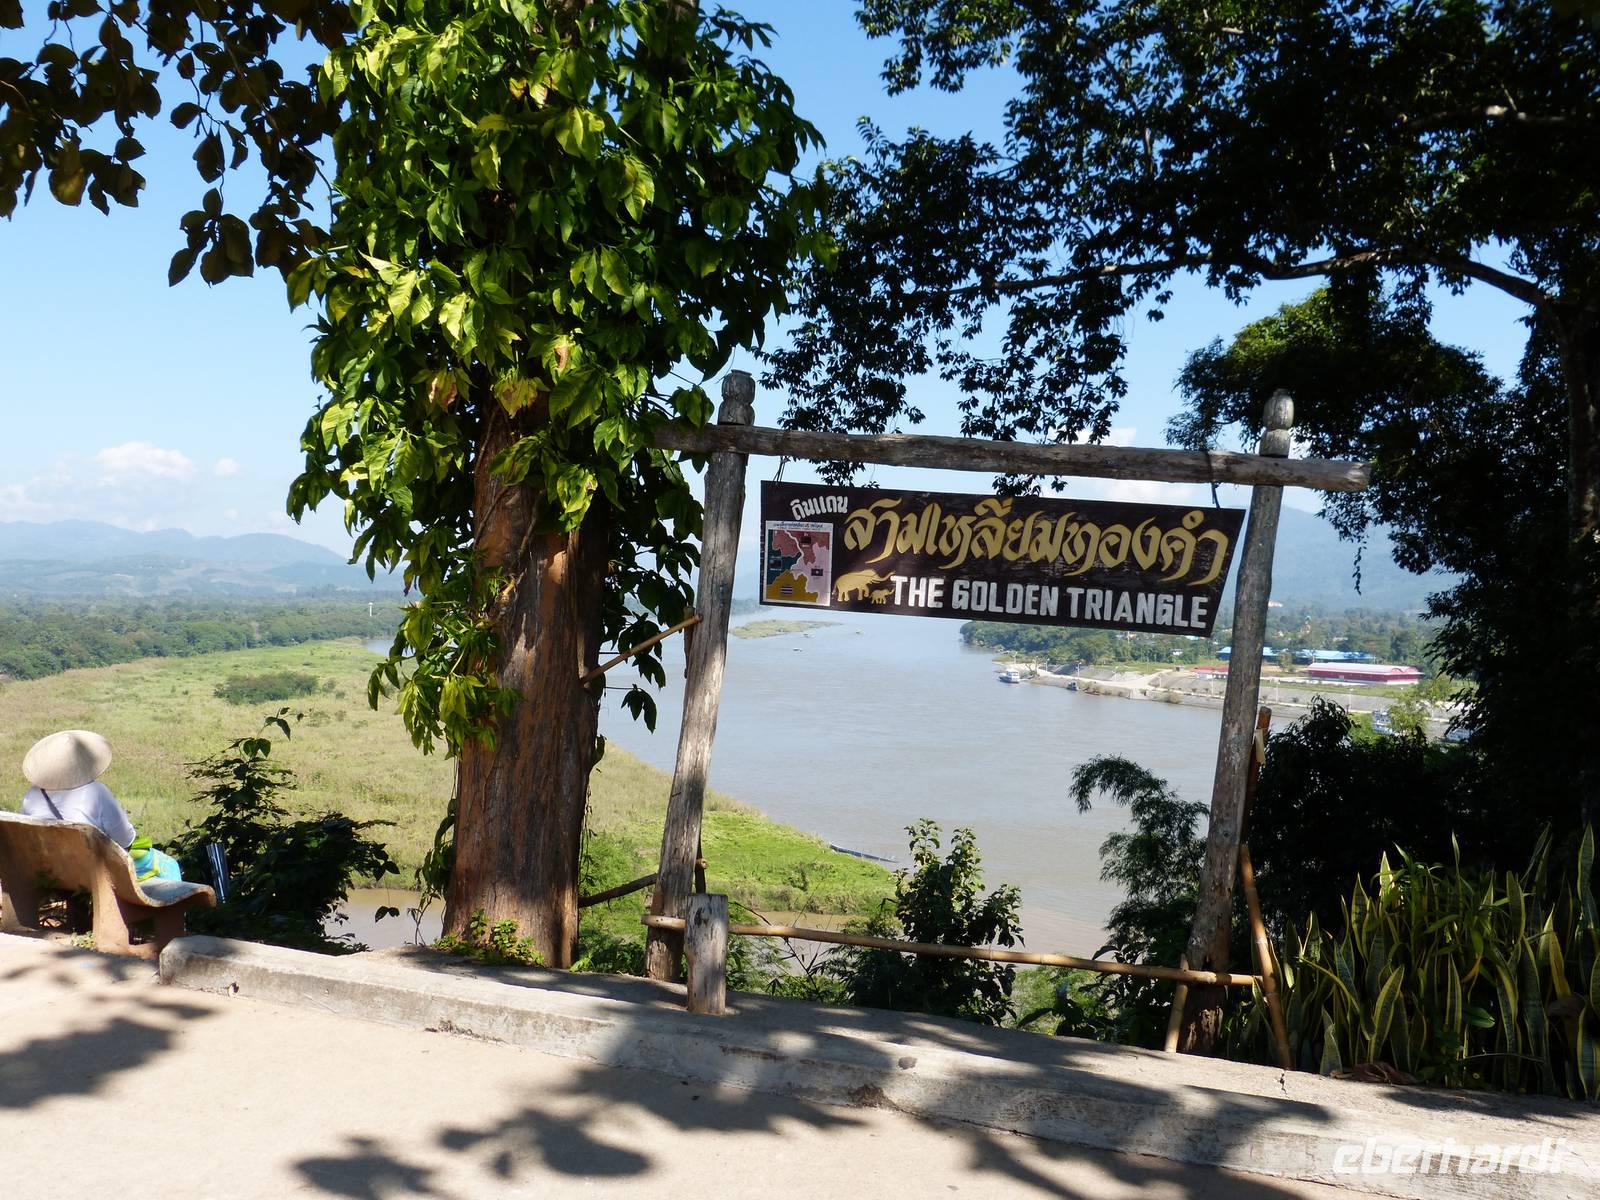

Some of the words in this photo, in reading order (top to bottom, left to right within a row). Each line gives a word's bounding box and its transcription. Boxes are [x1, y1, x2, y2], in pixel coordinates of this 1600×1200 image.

[890, 575, 945, 609] THE
[952, 579, 1059, 617] GOLDEN
[1066, 587, 1209, 629] TRIANGLE
